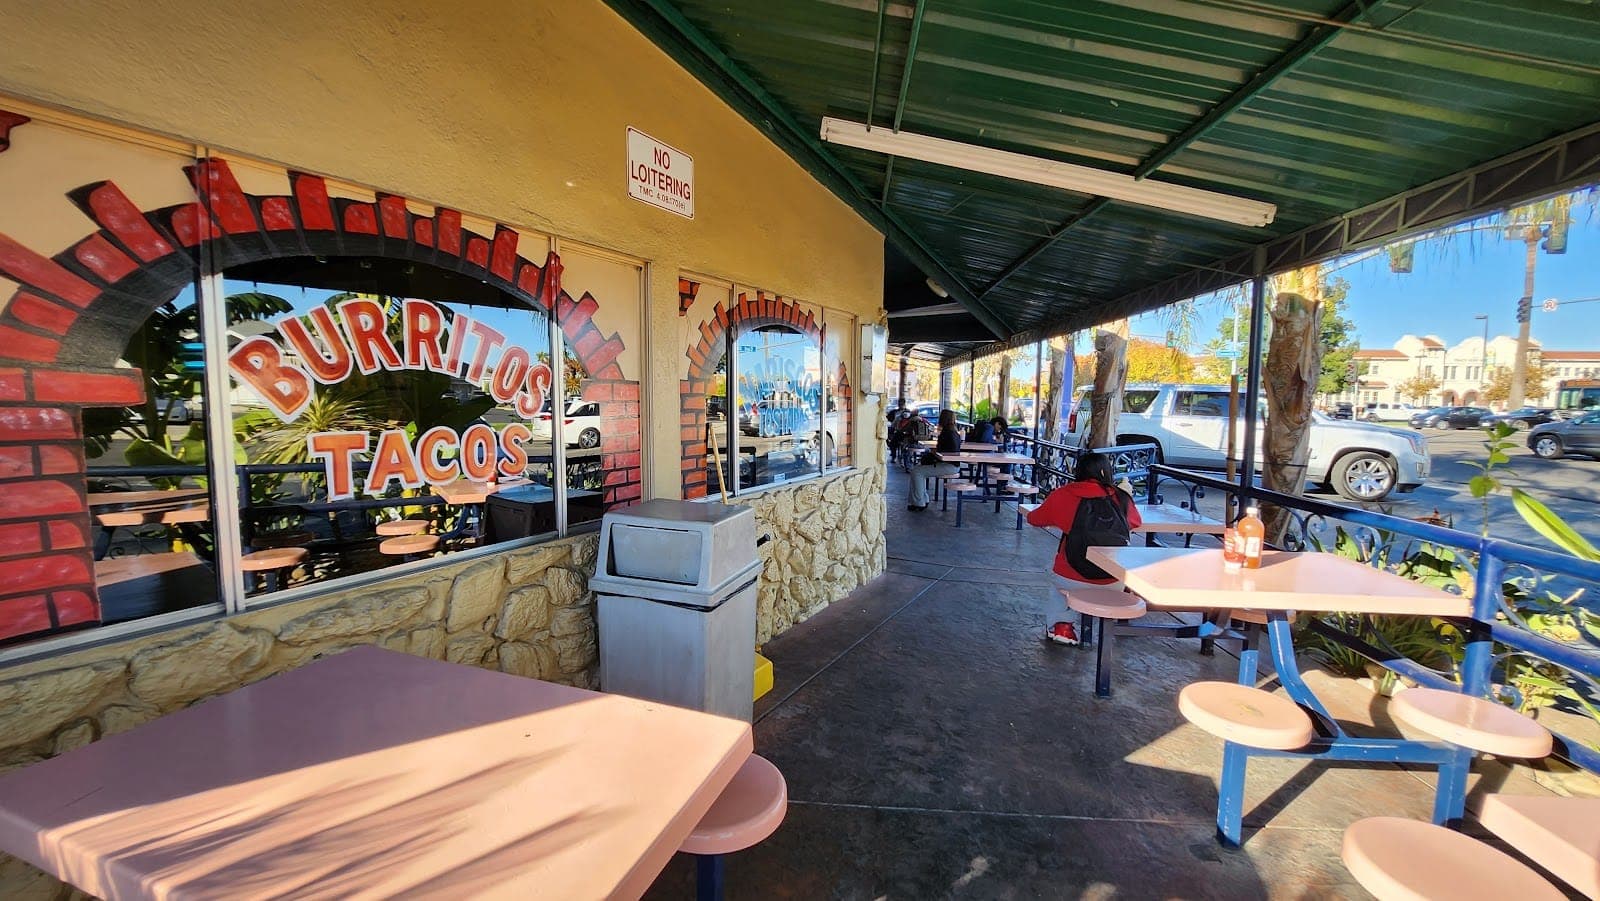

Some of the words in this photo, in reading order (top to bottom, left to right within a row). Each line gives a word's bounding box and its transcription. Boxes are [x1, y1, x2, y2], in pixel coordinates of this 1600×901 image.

[654, 147, 670, 170] NO
[631, 160, 691, 200] LOITERING
[639, 185, 654, 198] TMC
[227, 298, 552, 424] BURRITOS
[307, 423, 532, 499] TACOS
